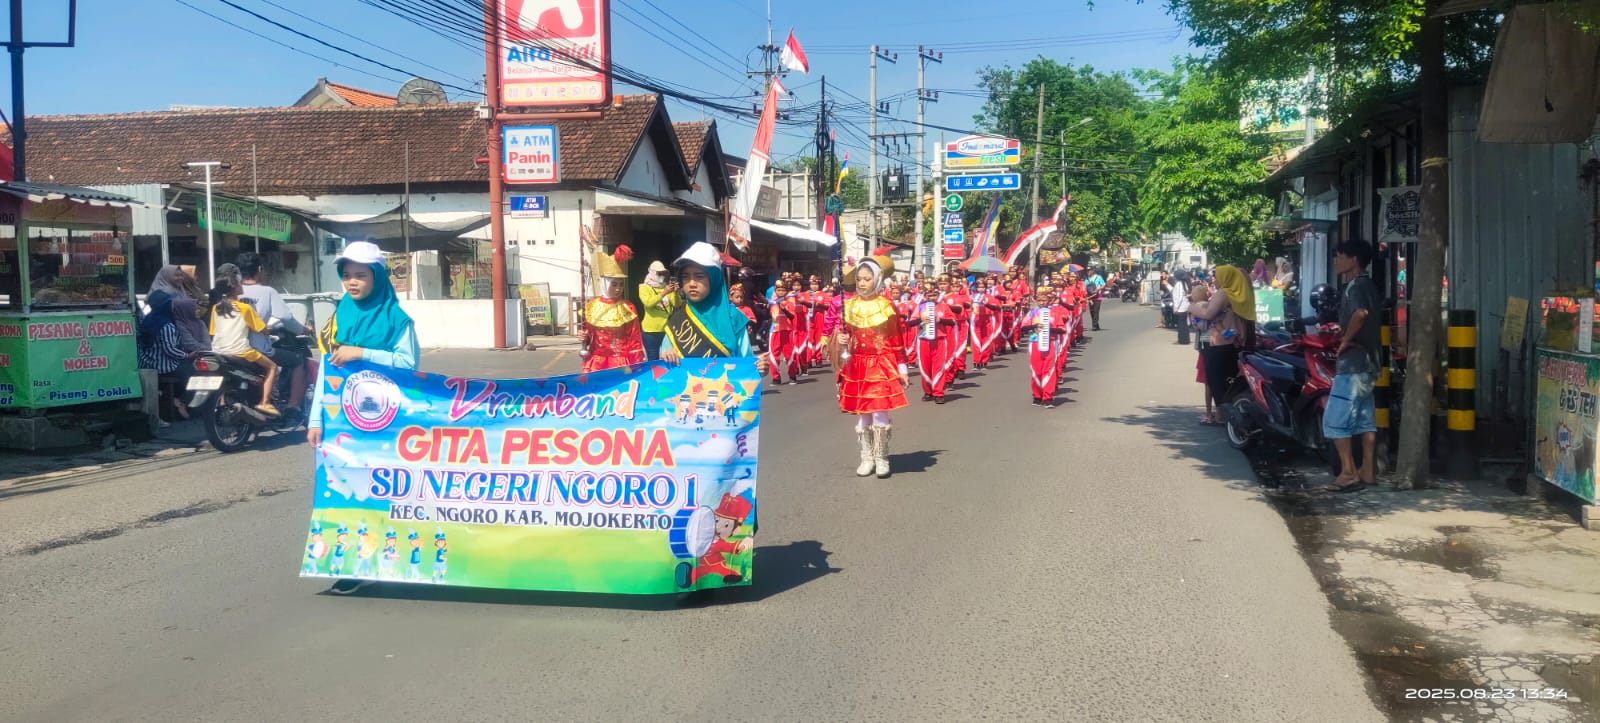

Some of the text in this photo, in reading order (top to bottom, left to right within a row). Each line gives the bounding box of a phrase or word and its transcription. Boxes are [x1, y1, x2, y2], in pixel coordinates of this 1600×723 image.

[524, 135, 549, 146] ATM
[508, 151, 550, 163] Panin
[979, 153, 1006, 164] Fresh
[28, 321, 133, 340] PISANG AROMA
[675, 319, 702, 354] SDN
[78, 339, 91, 355] &
[63, 356, 108, 371] MOLEN
[49, 390, 88, 401] Pisang
[97, 386, 132, 397] Coklat
[445, 378, 640, 421] Drumband
[399, 427, 675, 466] GITA PESONA
[370, 467, 697, 508] SD NEGERI NGORO 1
[390, 504, 672, 530] KEC. NGORO KAB. MOJOKERTO
